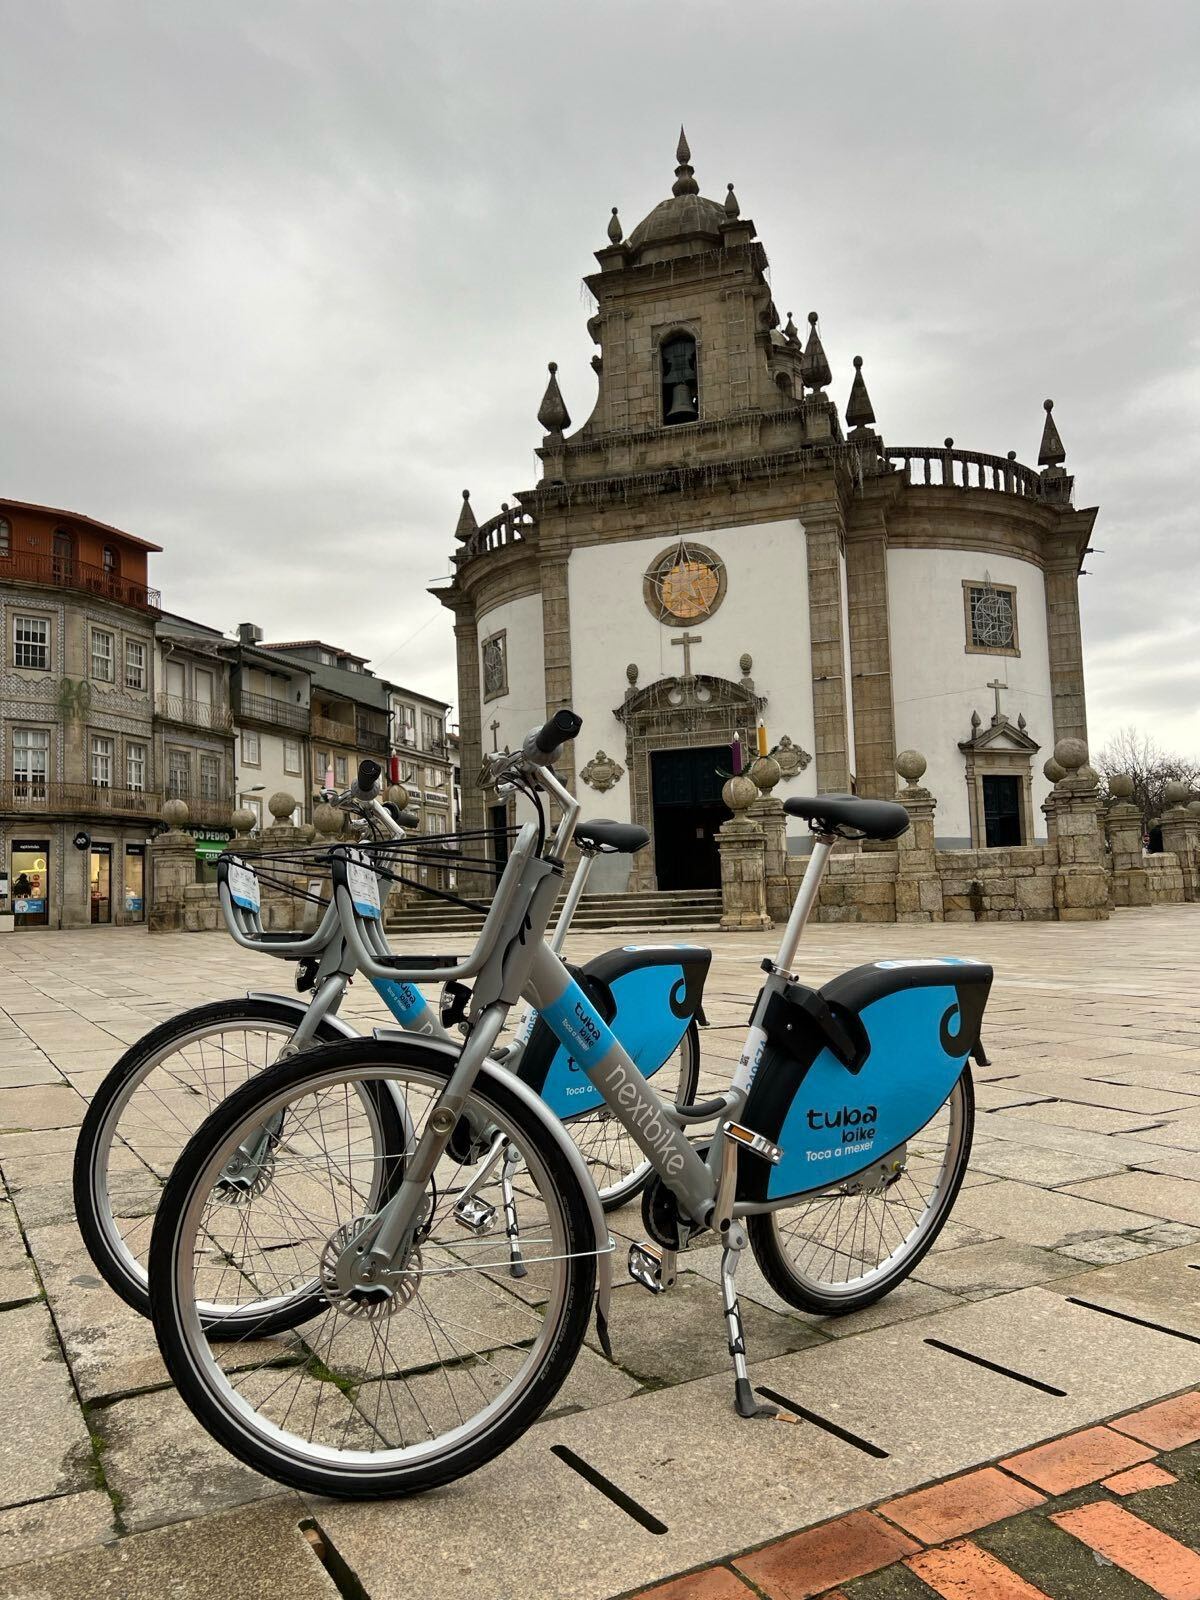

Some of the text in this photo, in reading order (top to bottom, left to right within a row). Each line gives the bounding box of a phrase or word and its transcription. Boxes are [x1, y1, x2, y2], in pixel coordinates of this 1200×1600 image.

[193, 831, 204, 839] DO
[205, 831, 229, 841] PEDRO
[562, 1018, 573, 1032] Toca
[575, 1002, 600, 1041] tuba
[580, 1027, 594, 1048] bike
[566, 1087, 584, 1096] Toca
[605, 1063, 685, 1176] nextbike
[807, 1106, 877, 1130] tuba
[842, 1127, 875, 1143] bike
[806, 1141, 874, 1161] Toca a mexer
